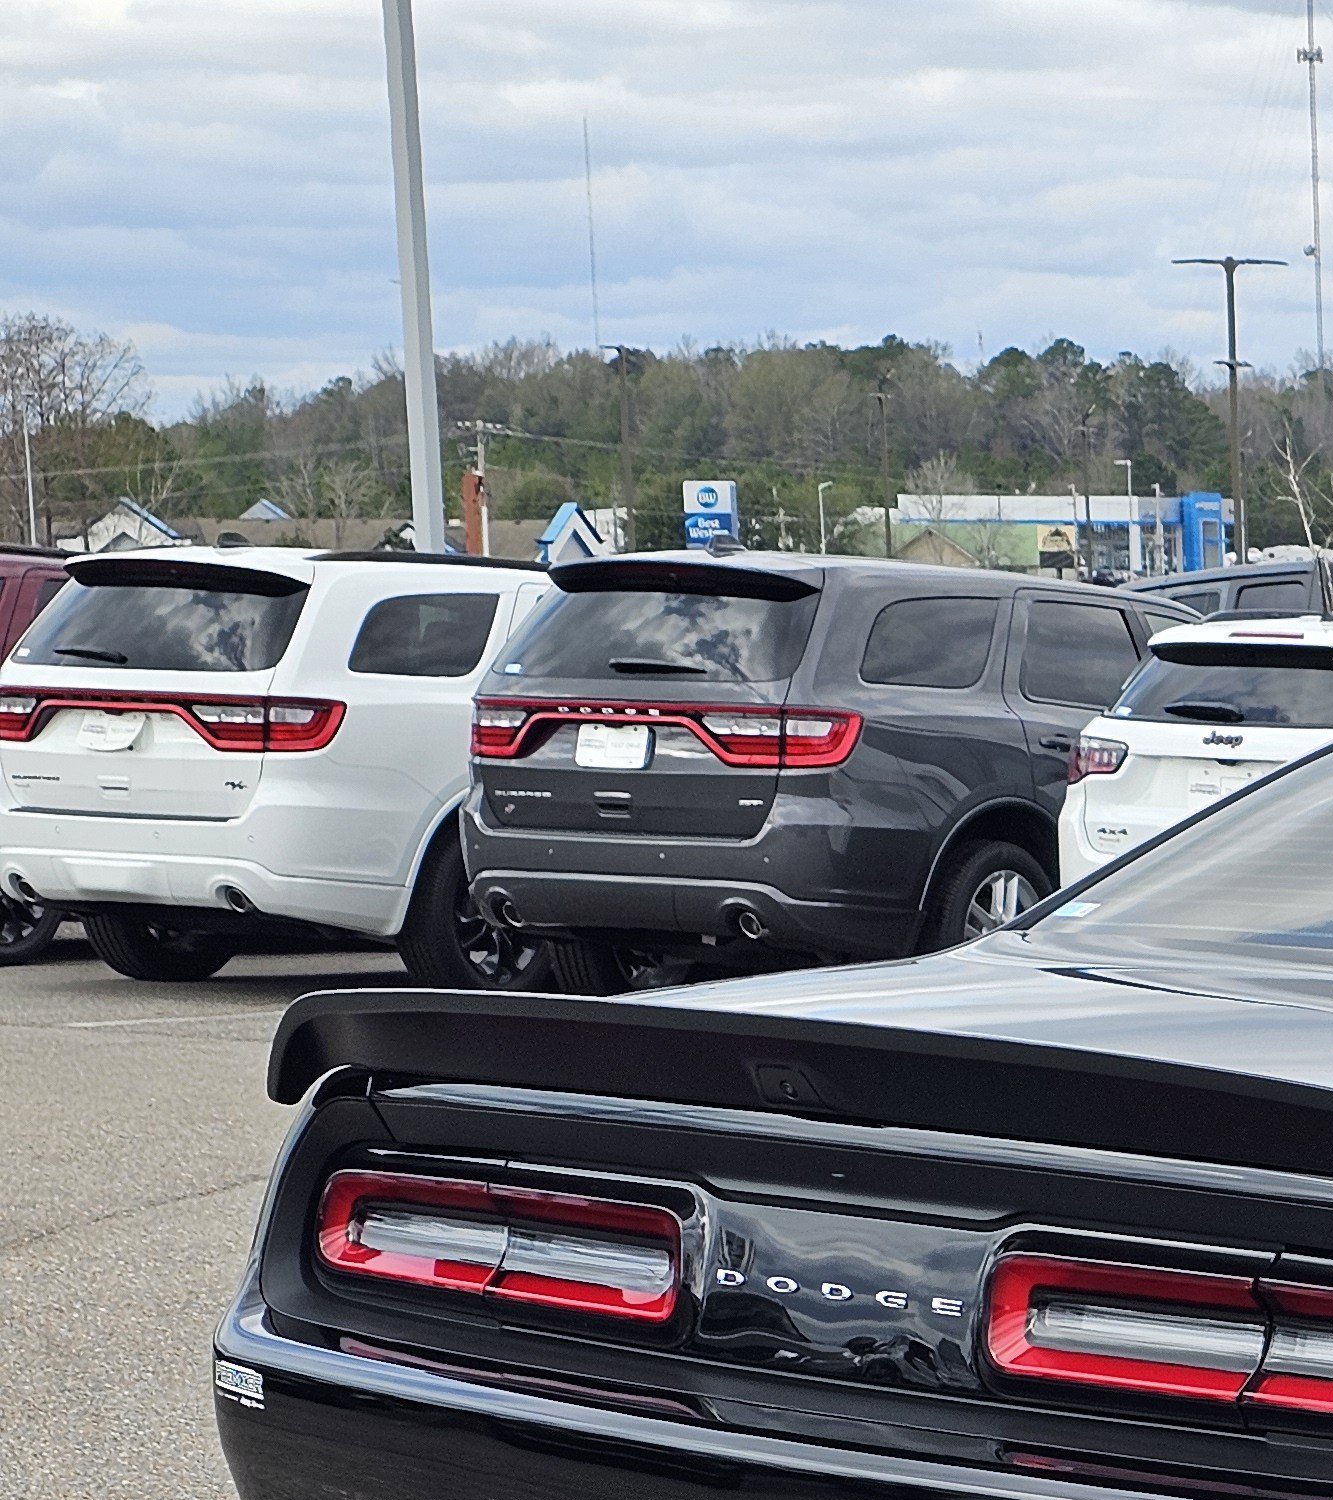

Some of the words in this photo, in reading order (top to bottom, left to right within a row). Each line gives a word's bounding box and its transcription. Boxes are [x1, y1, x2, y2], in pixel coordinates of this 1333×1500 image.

[698, 517, 720, 529] Best
[1202, 730, 1244, 749] Jeep
[716, 1267, 965, 1318] DODGE
